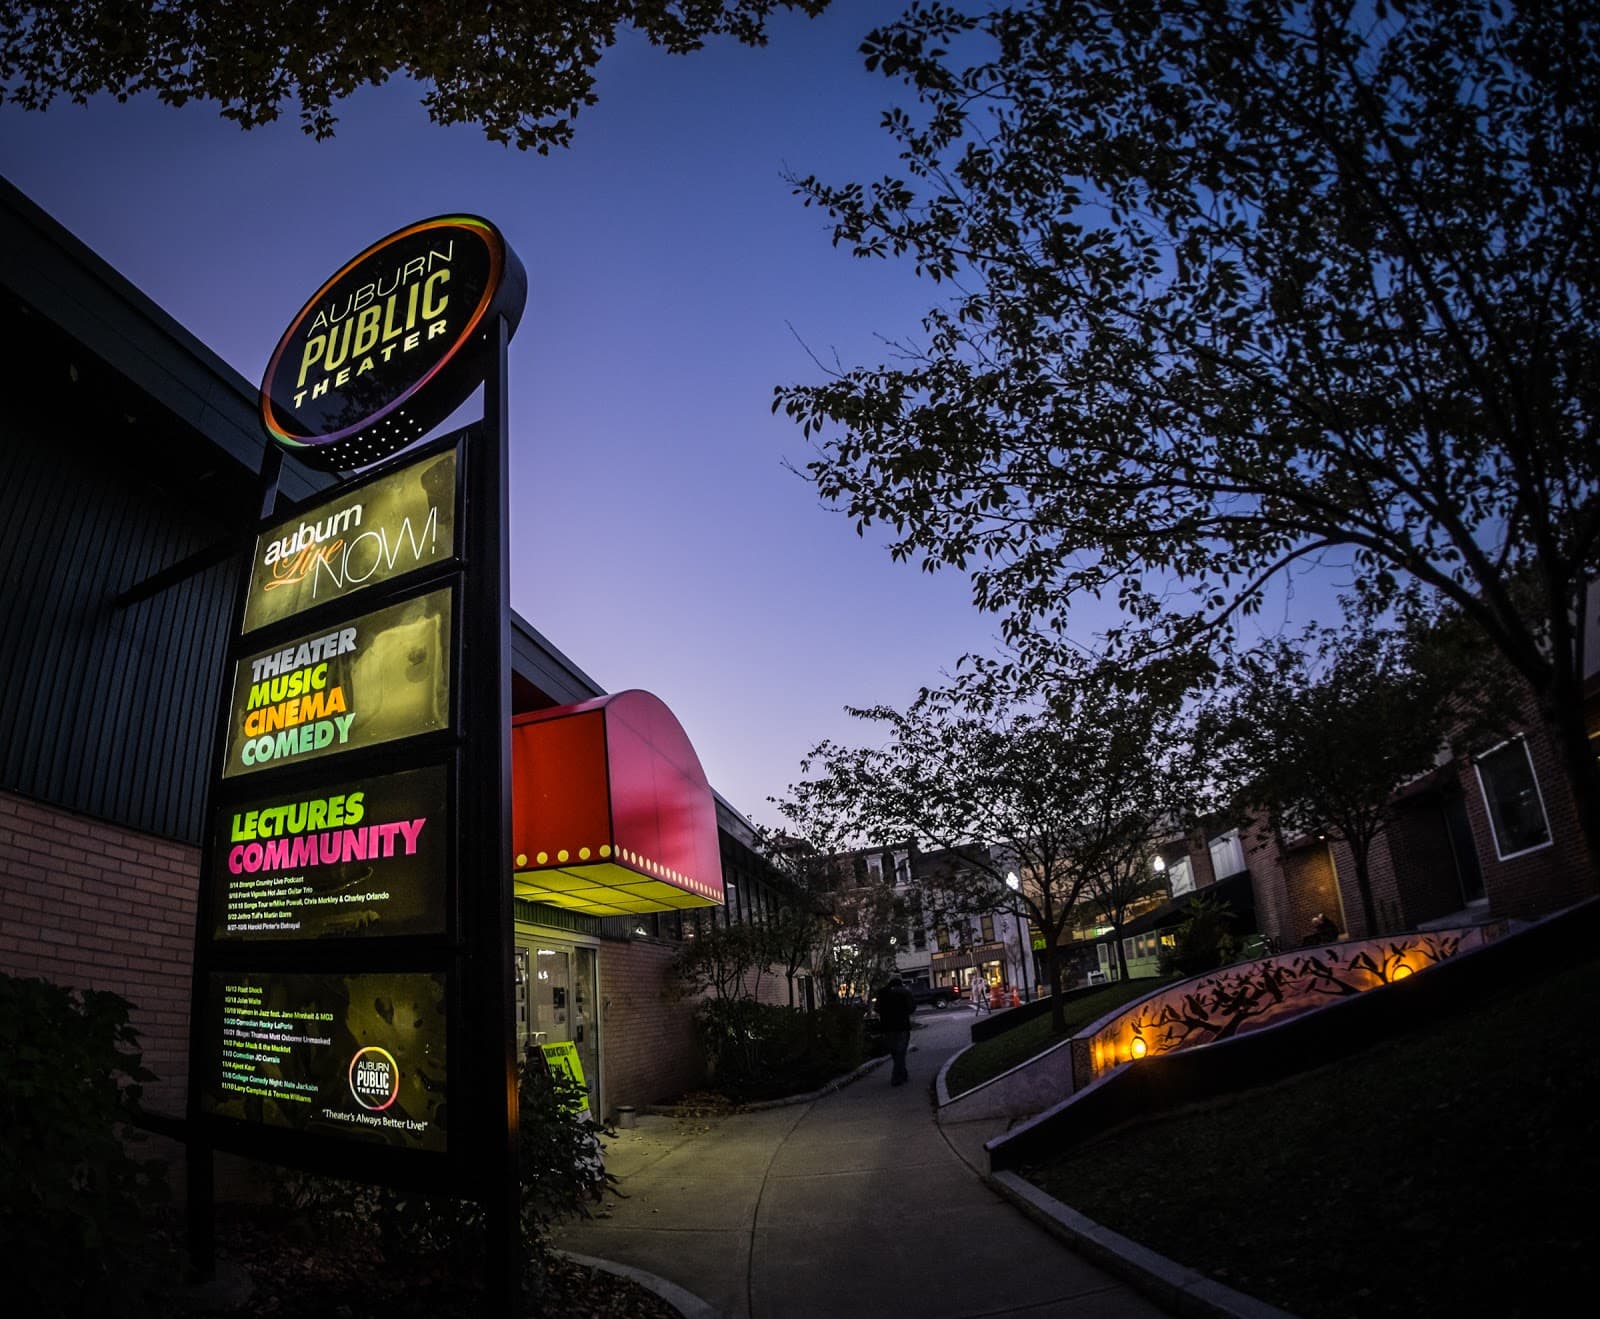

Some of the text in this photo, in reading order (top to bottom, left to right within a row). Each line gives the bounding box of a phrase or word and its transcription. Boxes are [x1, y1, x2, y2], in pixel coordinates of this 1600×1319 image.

[307, 240, 454, 337] AUBURN
[296, 268, 451, 388] PUBLIC
[292, 319, 447, 409] THEATER
[264, 503, 363, 565] auburn
[313, 506, 438, 598] NOW!
[252, 627, 357, 682] THEATER
[244, 686, 346, 737] CINEMA
[246, 662, 328, 711] MUSIC
[241, 712, 356, 766] COMEDY
[230, 791, 365, 843] LECTURES
[228, 818, 427, 875] COMMUNITY
[357, 1070, 389, 1089] PUBLIC
[357, 1087, 389, 1096] THEATER
[358, 1061, 389, 1072] AUBURN
[356, 1114, 381, 1127] Always
[382, 1117, 406, 1129] Better
